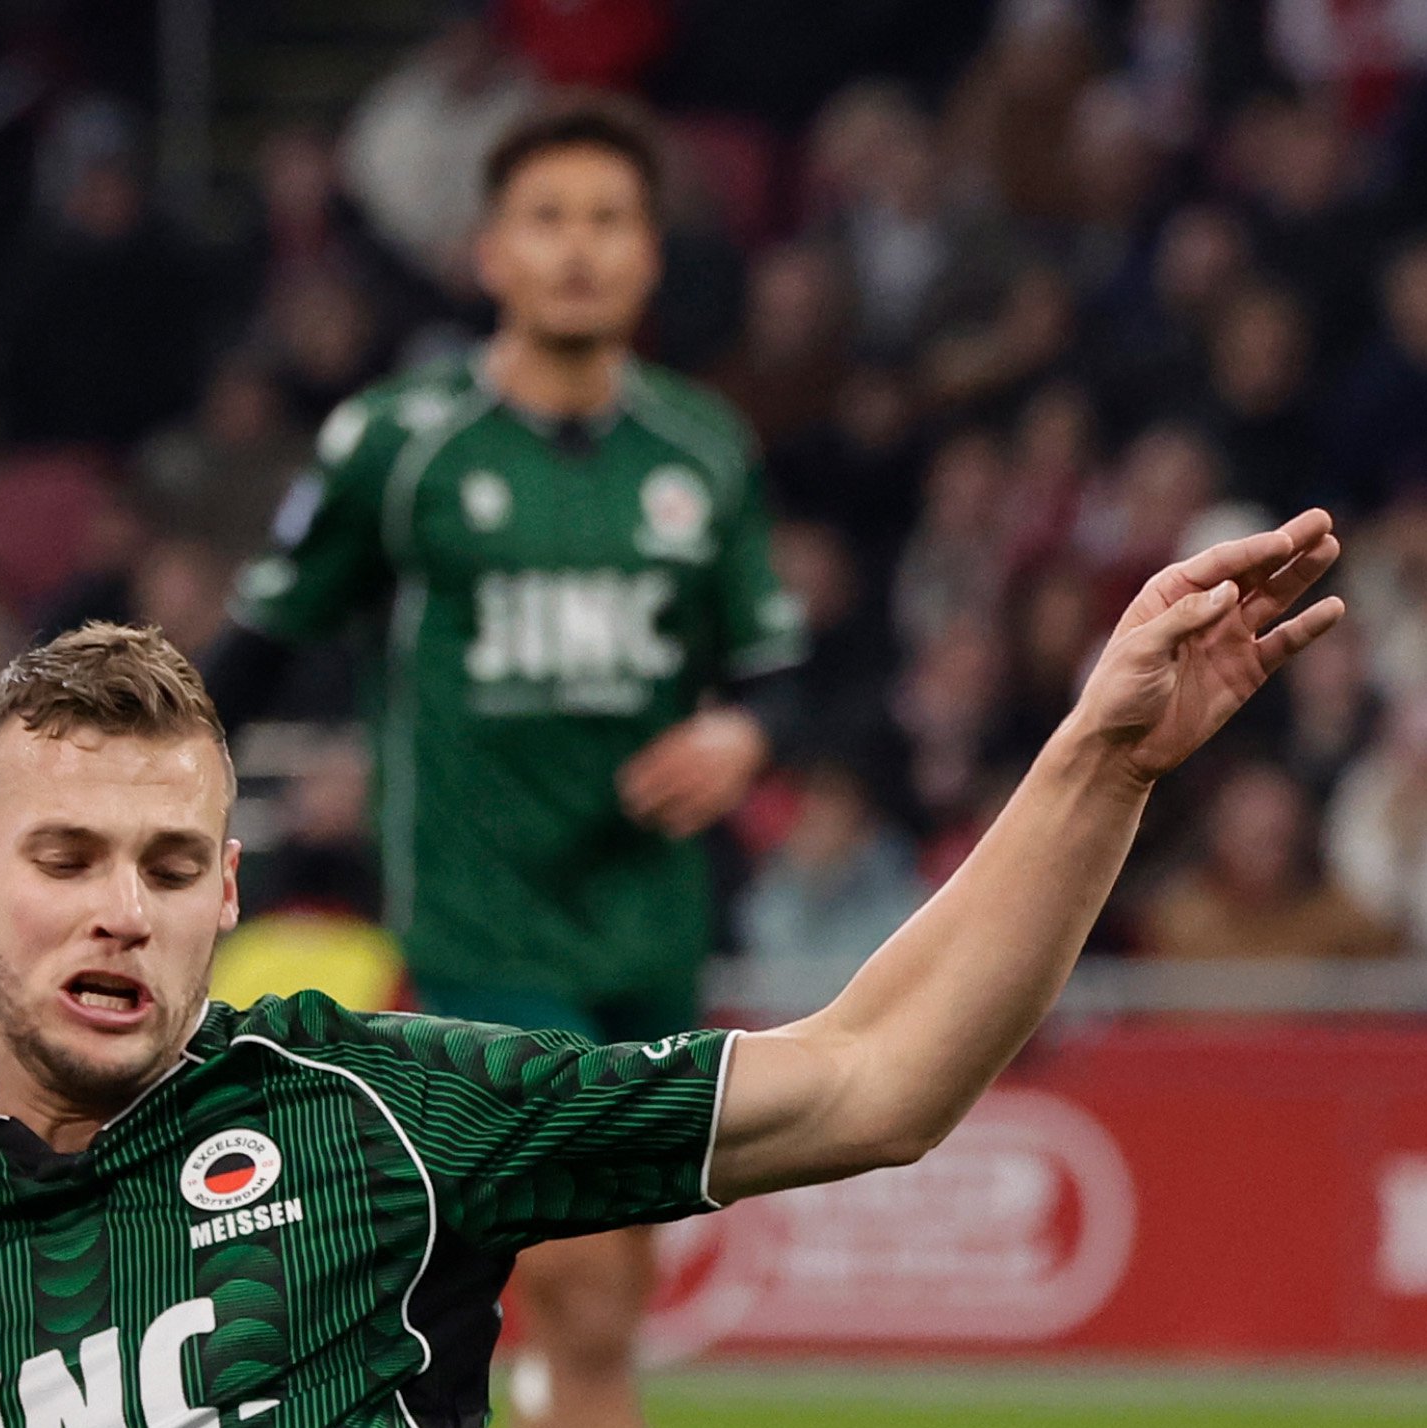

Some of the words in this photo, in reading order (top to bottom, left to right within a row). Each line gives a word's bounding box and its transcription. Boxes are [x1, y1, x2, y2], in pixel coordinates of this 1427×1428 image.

[193, 1137, 266, 1170] EXCELSIOR
[195, 1176, 268, 1206] ROTTERDAM
[189, 1197, 303, 1250] MEISSEN
